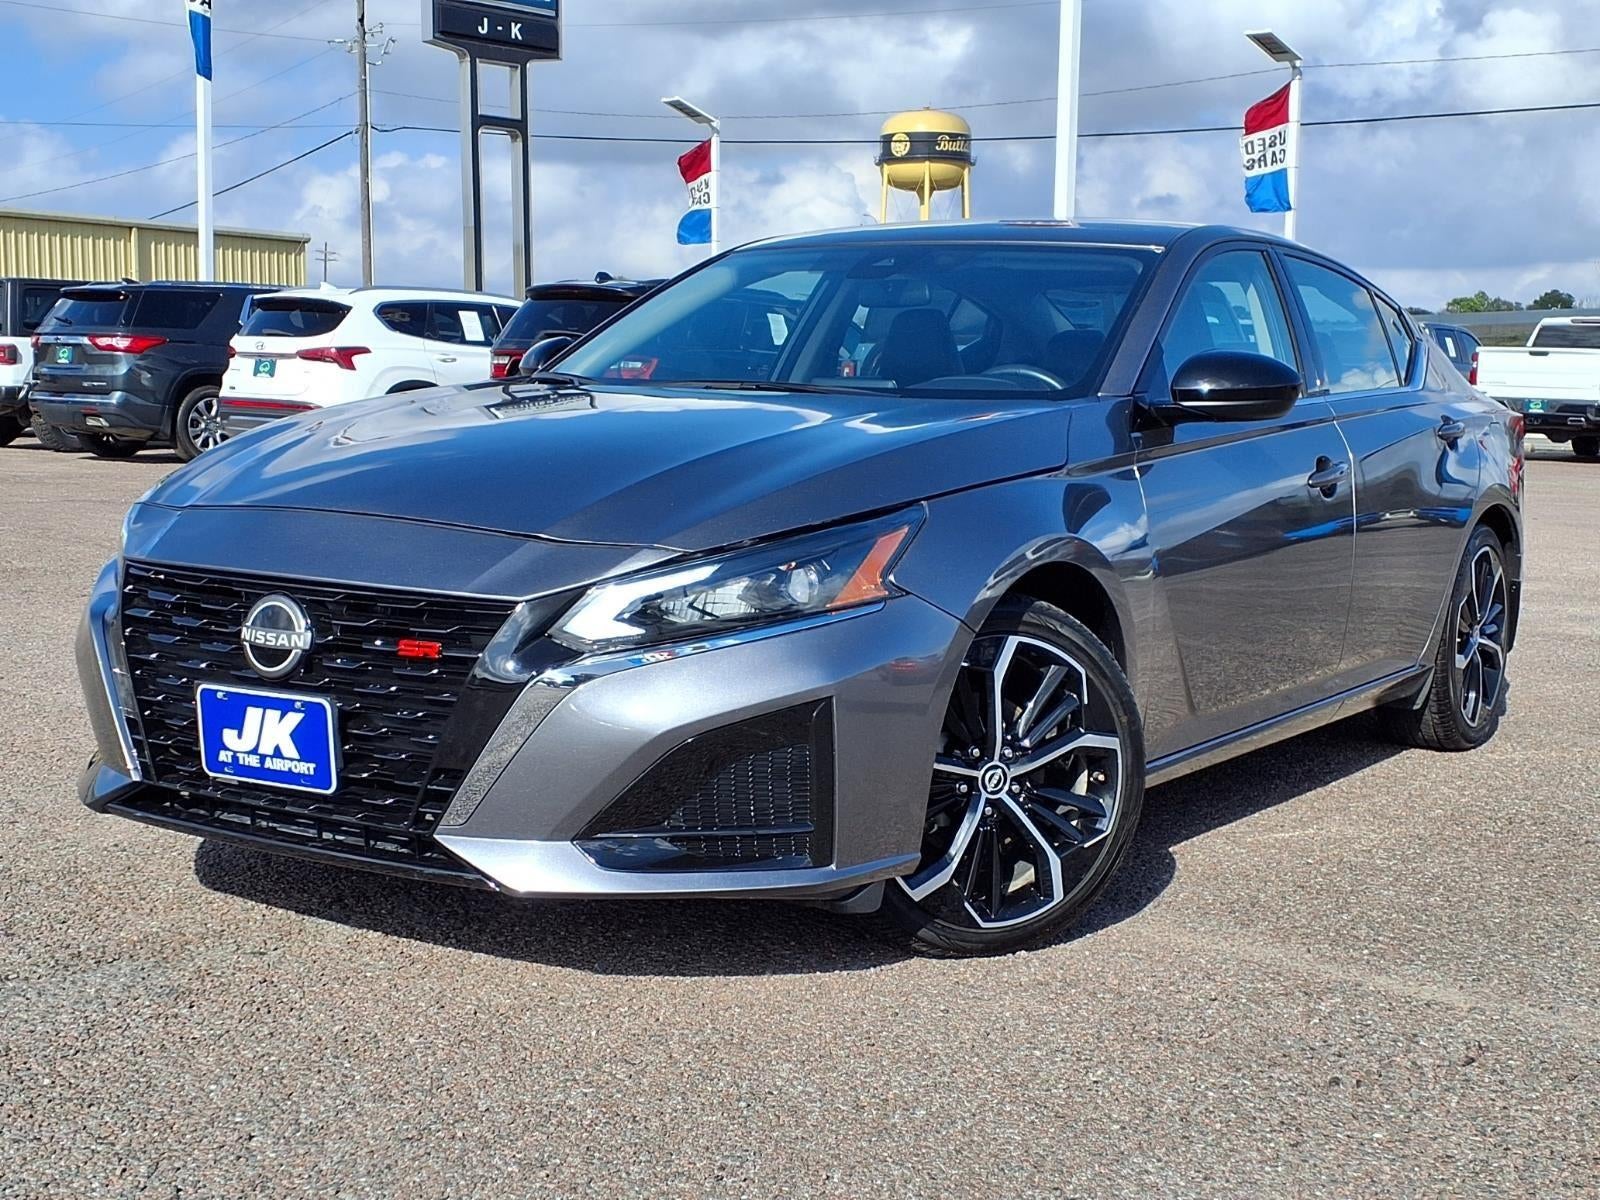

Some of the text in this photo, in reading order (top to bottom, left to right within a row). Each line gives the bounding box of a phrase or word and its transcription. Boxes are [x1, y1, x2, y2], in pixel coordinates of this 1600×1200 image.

[241, 626, 305, 648] NISSAN
[222, 705, 306, 760] JK
[218, 749, 317, 776] AT THE AIRPORT
